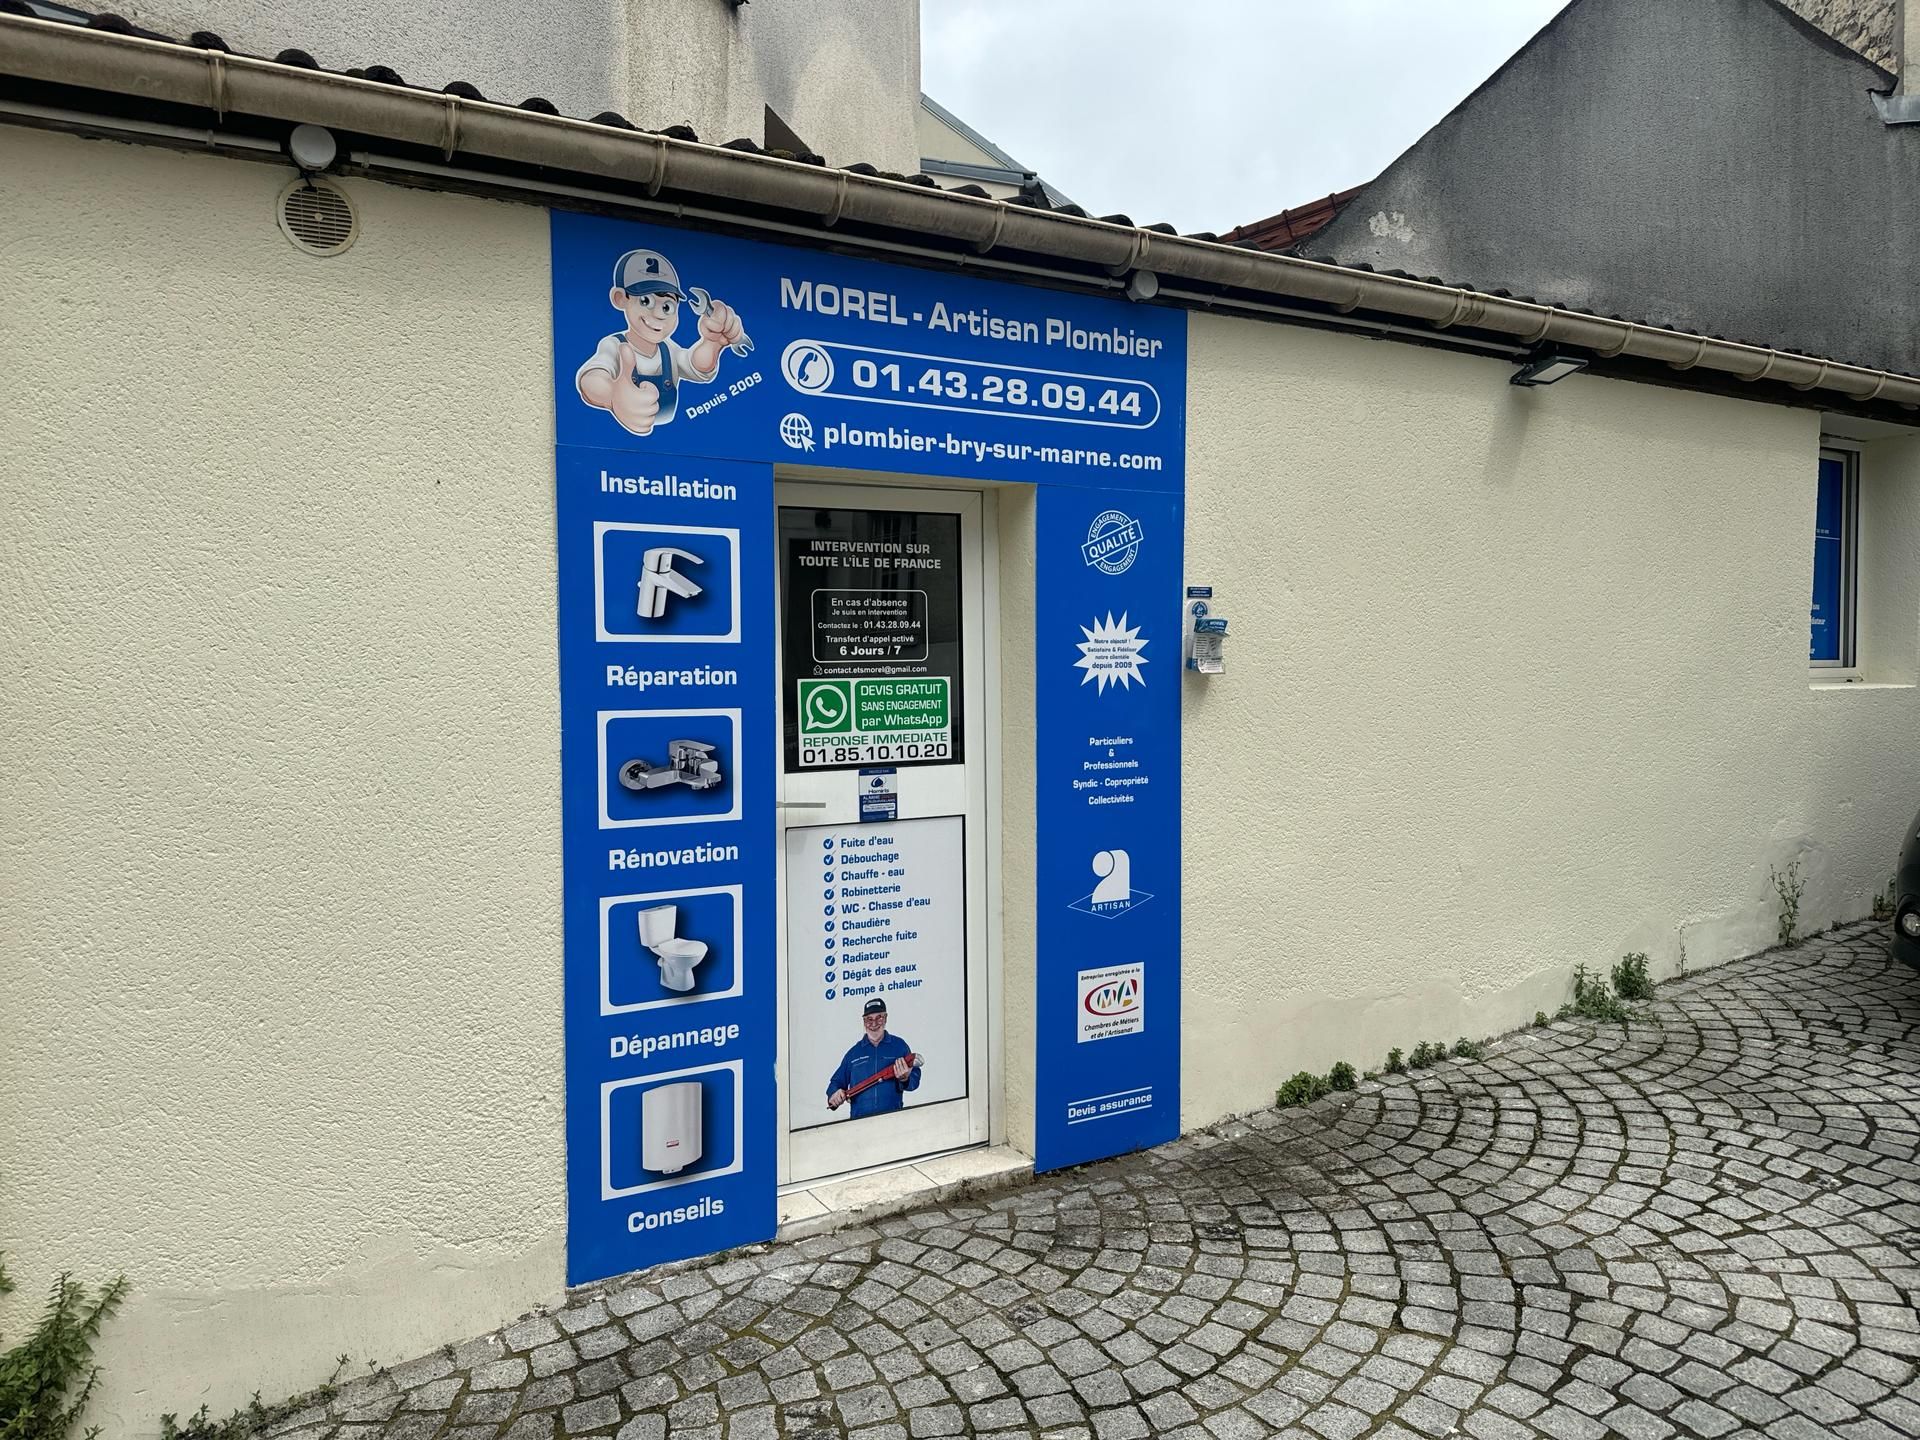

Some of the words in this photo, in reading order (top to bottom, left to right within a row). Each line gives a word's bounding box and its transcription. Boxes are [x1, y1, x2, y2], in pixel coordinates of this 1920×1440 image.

[781, 277, 908, 326] MOREL
[928, 301, 1039, 344] Artisan
[1046, 317, 1163, 358] Plombier
[685, 393, 728, 420] Depuis
[729, 371, 763, 396] 2009
[852, 358, 1142, 418] 01.43.28.09.44
[824, 422, 1163, 471] plombier-bry-sur-marne.com
[600, 470, 737, 501] Installation
[1091, 513, 1128, 538] ENGAGEMENT
[811, 541, 901, 554] INTERVENTION
[906, 543, 930, 554] SUR
[1089, 525, 1136, 558] QUALITÉ
[799, 556, 838, 567] TOUTE
[843, 554, 869, 568] L'ÎLE
[874, 557, 890, 568] DE
[894, 558, 941, 569] FRANCE
[1100, 549, 1135, 572] ENGAGEMENT
[831, 598, 843, 607] En
[845, 599, 861, 607] cas
[863, 598, 907, 607] d'absence
[818, 621, 851, 629] Contactez
[863, 620, 921, 629] 01.43.28.09.44
[826, 635, 860, 643] Transfert
[862, 635, 890, 644] d'appel
[892, 634, 914, 642] activé
[839, 645, 847, 655] 6
[850, 645, 884, 655] Jours
[894, 645, 901, 655] 7
[824, 665, 927, 675] contact.etsmorel@gmail.com
[1092, 662, 1113, 670] depuis
[606, 665, 737, 691] Réparation
[860, 684, 893, 696] DEVIS
[896, 683, 942, 695] GRATUIT
[861, 701, 885, 711] SANS
[886, 699, 942, 711] ENGAGEMENT
[862, 716, 881, 729] par
[883, 713, 942, 727] WhatsApp
[803, 735, 868, 748] REPONSE
[873, 732, 948, 745] IMMEDIATE
[1089, 736, 1133, 746] Particuliers
[803, 743, 948, 763] 01.85.10.10.20
[1108, 748, 1114, 757] &
[1083, 760, 1138, 770] Professionnels
[1073, 778, 1098, 791] Syndic
[1104, 776, 1149, 788] Copropriété
[1088, 794, 1134, 805] Collectivités
[841, 838, 865, 848] Fuite
[868, 836, 894, 846] d'eau
[608, 842, 738, 871] Rénovation
[841, 852, 900, 865] Débouchage
[841, 869, 879, 881] Chauffe
[888, 868, 905, 877] eau
[841, 883, 901, 898] Robinetterie
[842, 903, 860, 914] WC
[868, 900, 903, 912] Chasse
[906, 897, 931, 907] d'eau
[1091, 900, 1131, 912] ARTISAN
[842, 918, 891, 930] Chaudière
[842, 932, 893, 947] Recherche
[896, 930, 918, 941] fuite
[842, 951, 890, 964] Radiateur
[843, 968, 872, 981] Dégât
[875, 966, 892, 976] des
[895, 964, 917, 973] eaux
[843, 985, 875, 997] Pompe
[879, 982, 885, 992] à
[888, 979, 923, 991] chaleur
[1084, 1022, 1111, 1032] Chambres
[1120, 1017, 1139, 1026] Métiers
[610, 1022, 740, 1058] Dépannage
[1090, 1032, 1097, 1040] et
[1105, 1027, 1133, 1037] l'Artisanat
[1068, 1104, 1096, 1119] Devis
[1099, 1093, 1152, 1112] assurance
[627, 1195, 724, 1233] Conseils
